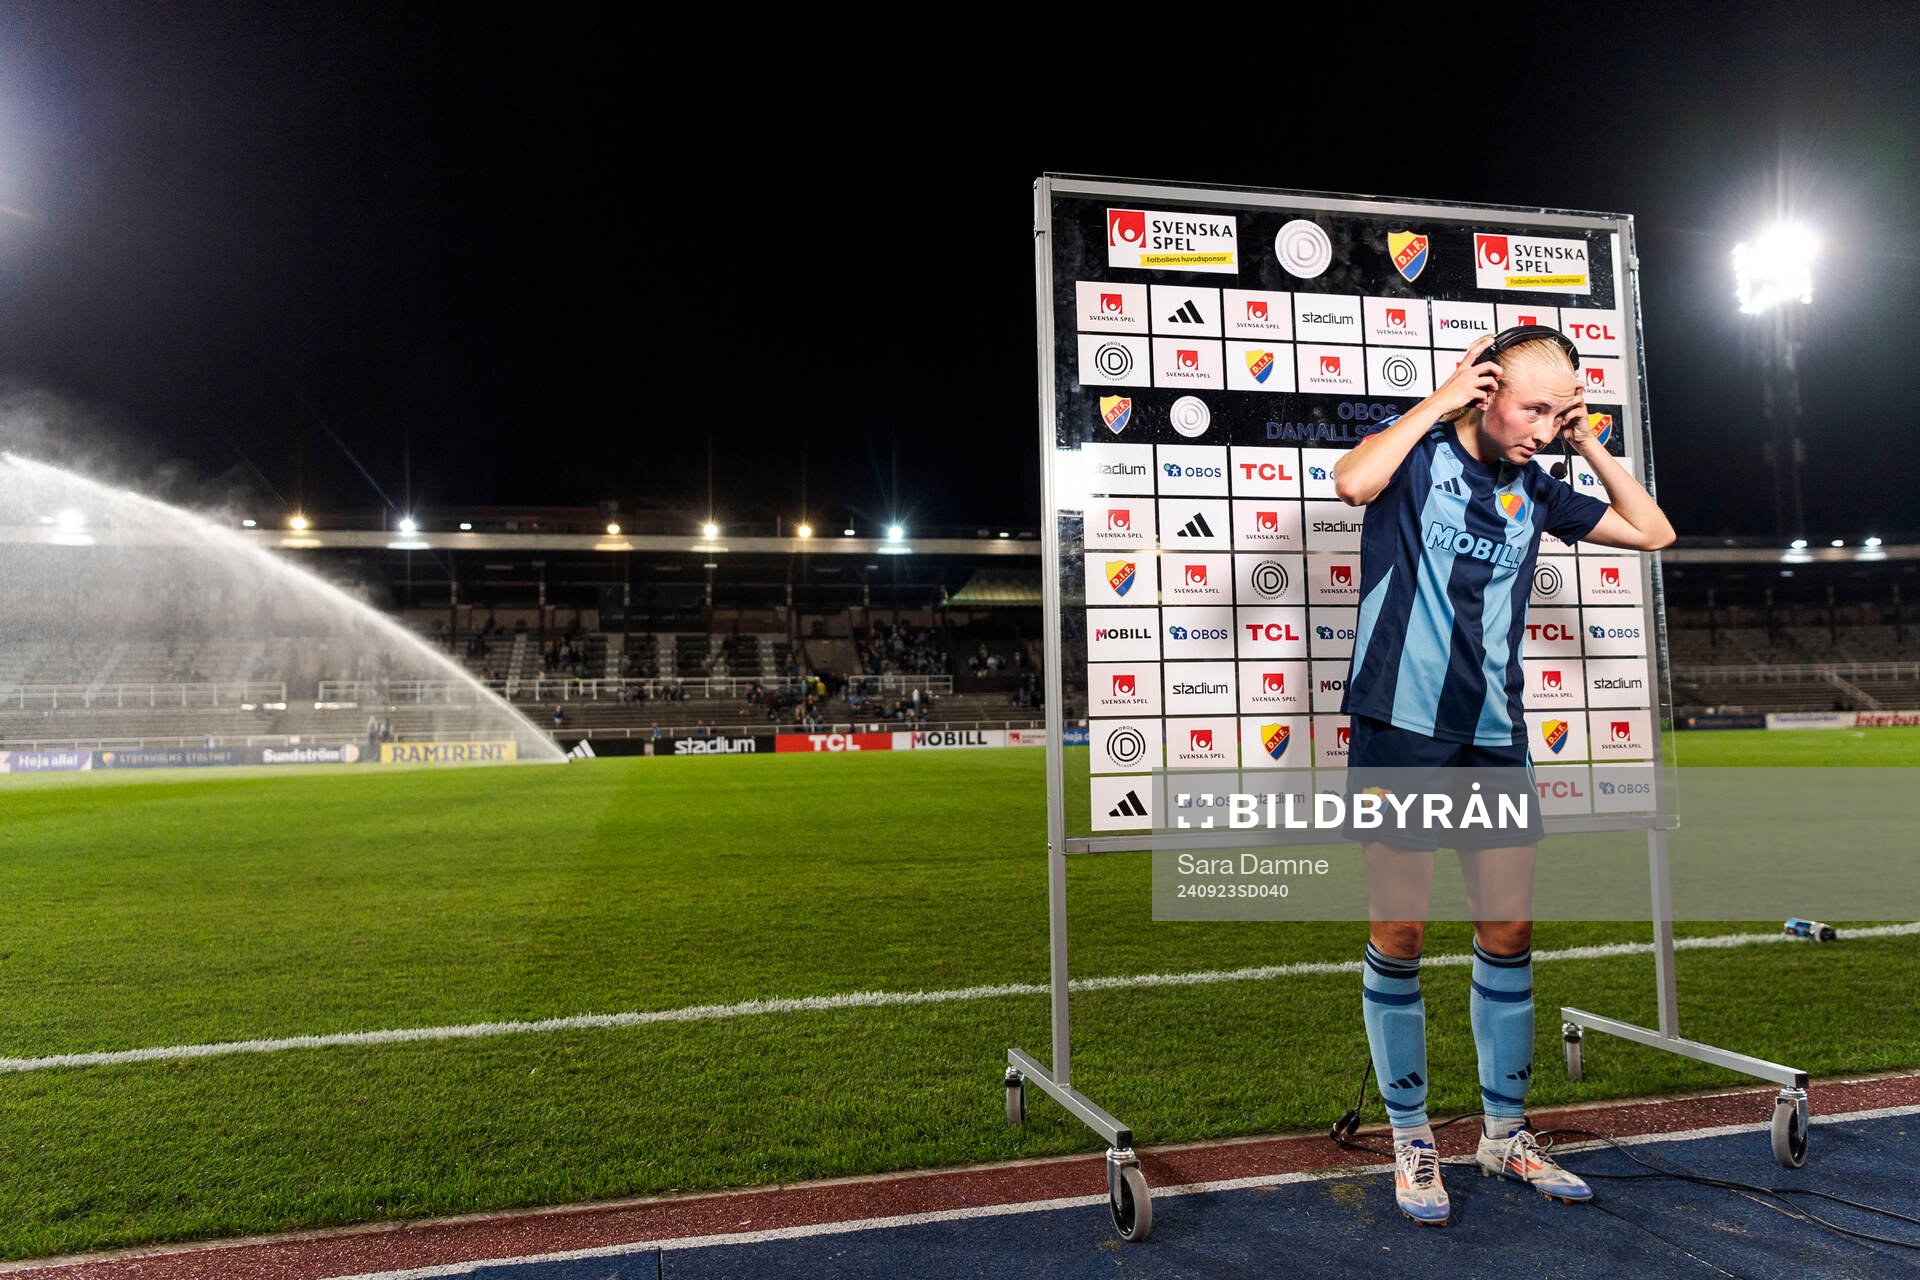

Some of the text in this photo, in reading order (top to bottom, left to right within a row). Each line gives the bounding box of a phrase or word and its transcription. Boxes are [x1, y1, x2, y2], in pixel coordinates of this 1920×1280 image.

[1152, 220, 1233, 237] SVENSKA
[1153, 237, 1195, 251] SPEL
[1514, 244, 1585, 260] SVENSKA
[1516, 260, 1552, 273] SPEL
[1302, 313, 1354, 324] stadium
[1440, 319, 1487, 330] MOBILL
[1569, 324, 1615, 340] TCL
[1337, 402, 1397, 420] OBOS
[1185, 467, 1221, 478] OBOS
[1240, 464, 1292, 481] TCL
[1426, 521, 1522, 569] MOBILL
[1112, 564, 1136, 586] D.I.F.
[1096, 628, 1151, 642] MOBILL
[1191, 629, 1228, 640] OBOS
[1246, 624, 1299, 641] TCL
[1526, 624, 1574, 640] TCL
[1608, 628, 1640, 639] OBOS
[1173, 682, 1228, 695] stadium
[1594, 677, 1642, 689] stadium
[674, 736, 755, 755] stadium
[809, 734, 860, 751] TCL
[912, 730, 987, 749] MOBILL
[1266, 727, 1289, 750] D.I.F.
[263, 747, 340, 763] Sundström
[391, 742, 508, 762] RAMIRENT
[19, 753, 48, 768] Heja
[1537, 782, 1583, 798] TCL
[1618, 783, 1650, 794] OBOS
